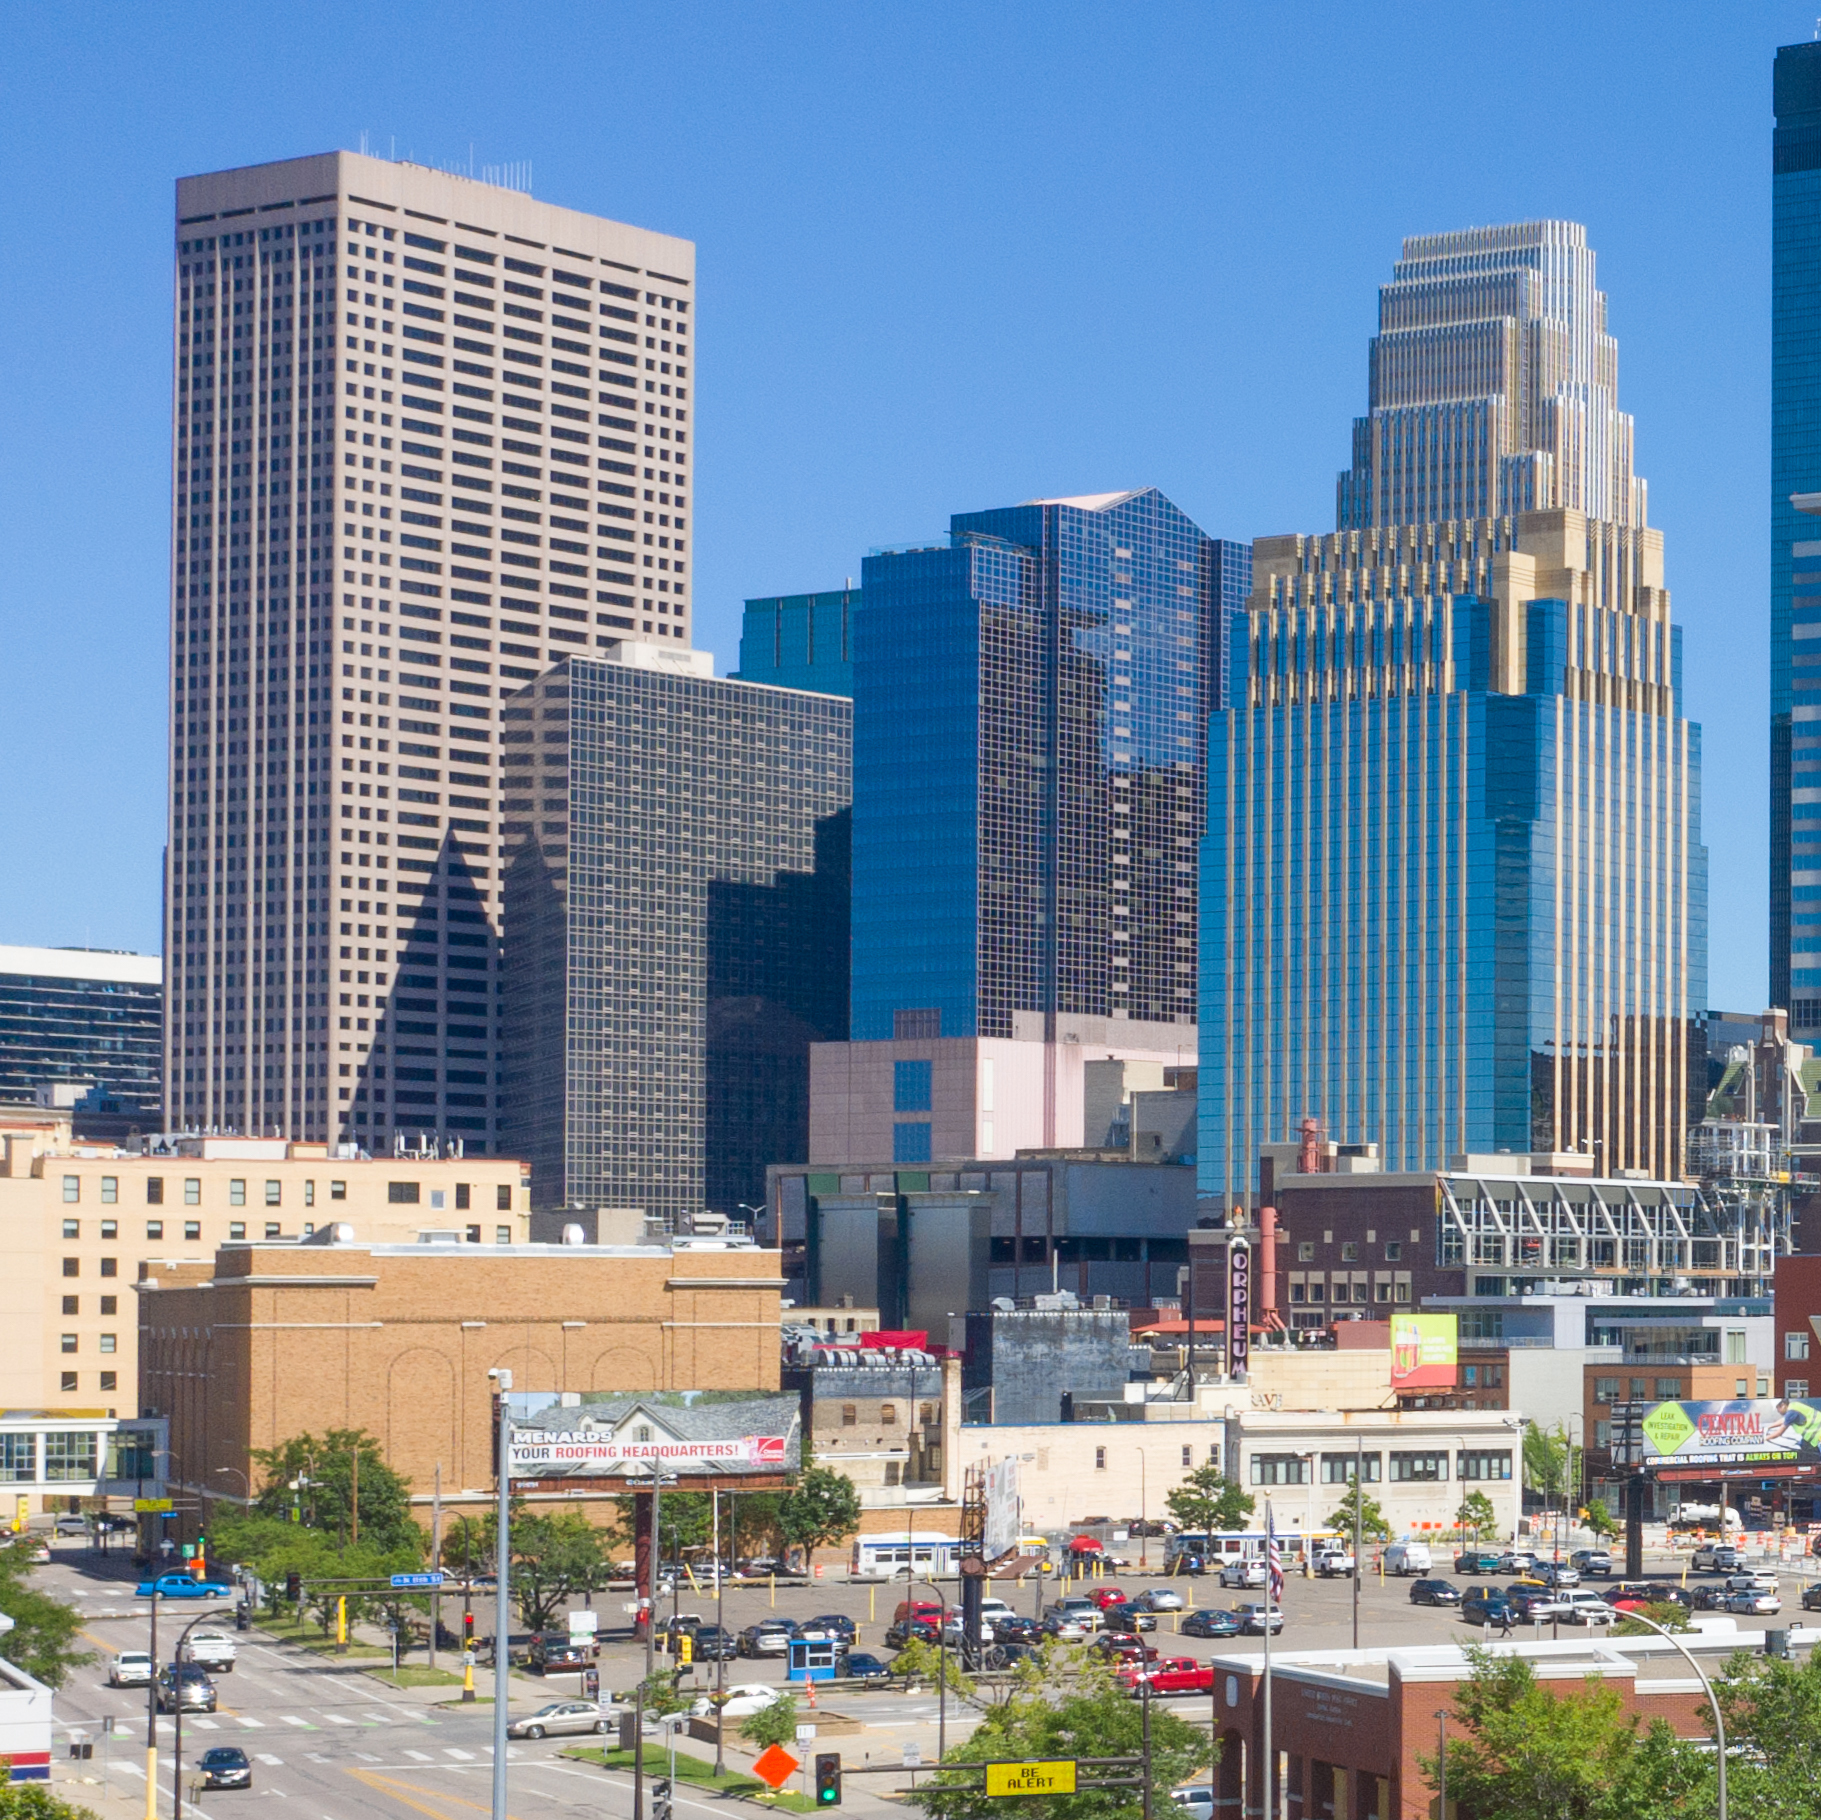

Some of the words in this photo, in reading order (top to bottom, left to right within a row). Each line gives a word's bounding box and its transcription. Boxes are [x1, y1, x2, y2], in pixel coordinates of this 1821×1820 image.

[1231, 1253, 1248, 1375] ORPHEUM
[1698, 1413, 1765, 1437] CENTRAL
[513, 1430, 613, 1444] MENARDS
[1699, 1436, 1730, 1446] ROOFING
[1731, 1435, 1764, 1445] COMPANY
[513, 1447, 550, 1459] YOUR
[555, 1446, 617, 1459] ROOFING
[622, 1444, 739, 1458] HEADQUARTERS!
[1021, 1767, 1040, 1778] BE
[1007, 1777, 1055, 1789] ALERT
